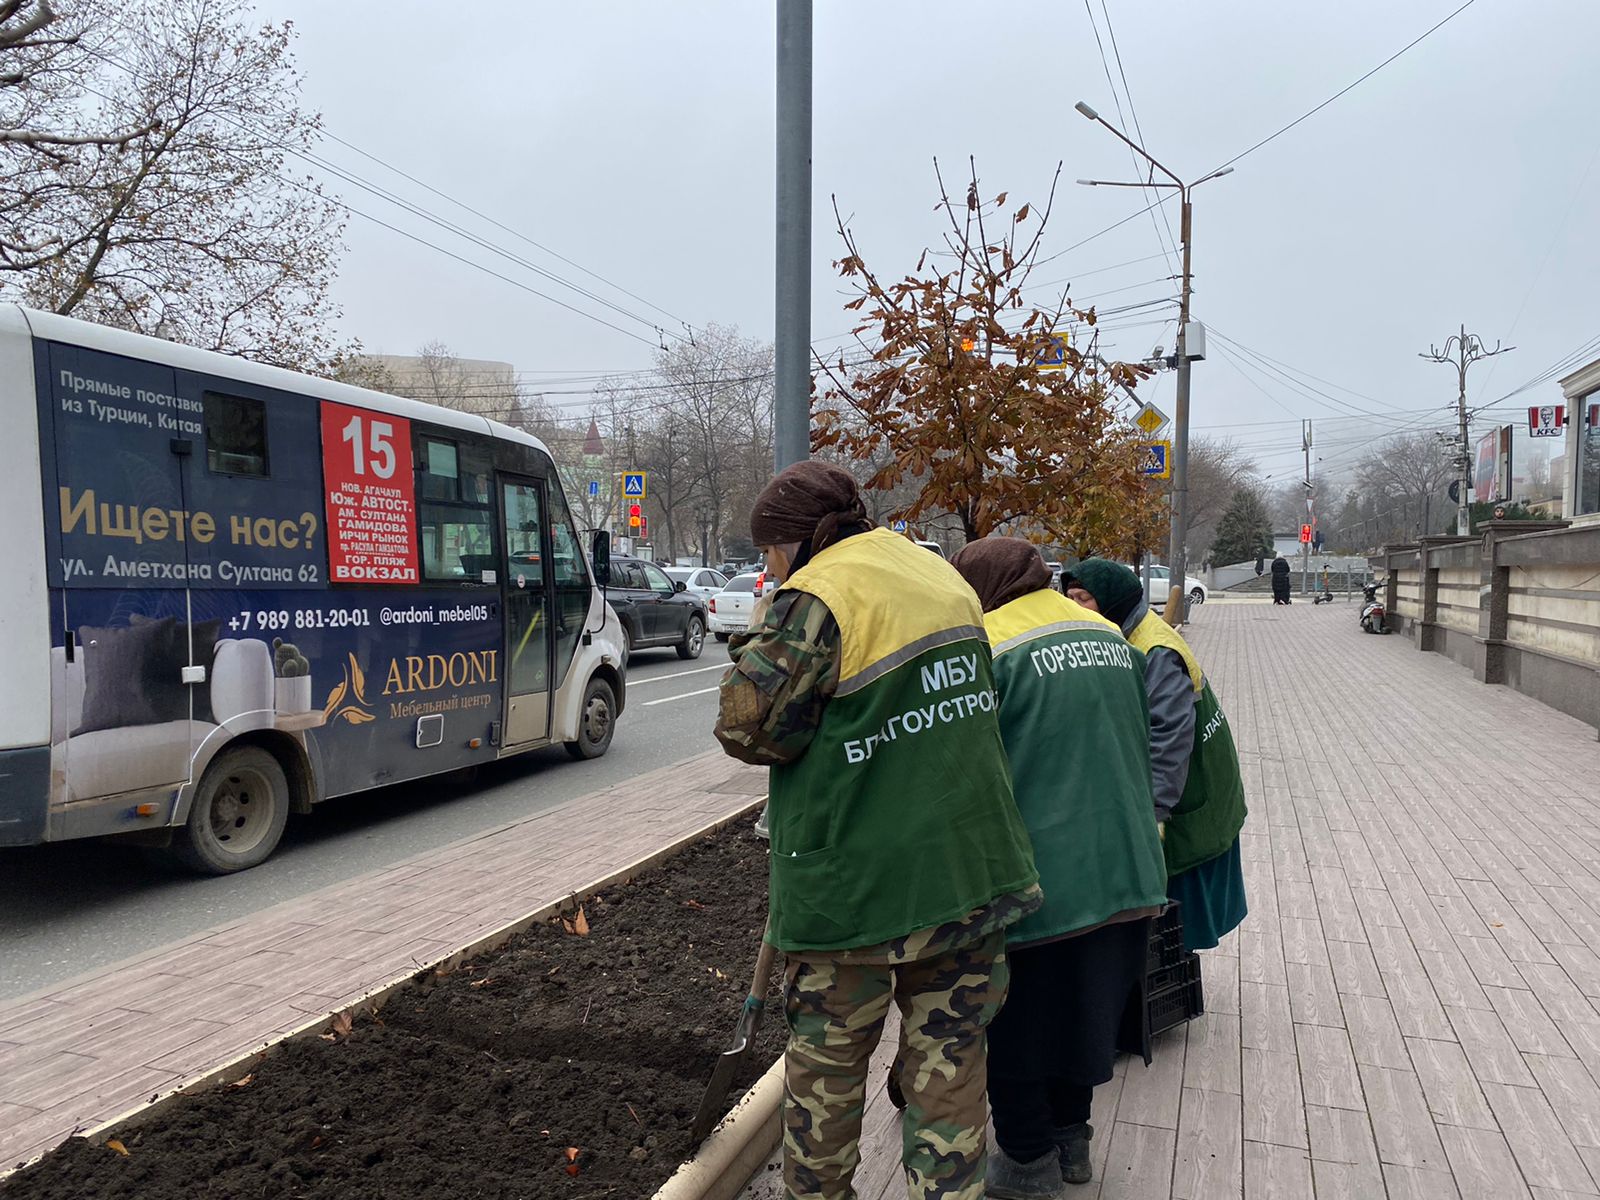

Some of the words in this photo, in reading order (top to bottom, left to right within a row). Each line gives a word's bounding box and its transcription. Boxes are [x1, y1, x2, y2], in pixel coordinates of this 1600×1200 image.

[60, 370, 132, 399] Прямые
[61, 398, 83, 413] из
[88, 399, 153, 428] Турции,
[158, 412, 202, 434] Китая
[342, 415, 396, 479] 15
[330, 491, 358, 506] Юж.
[361, 496, 412, 512] АВТОСТ.
[364, 485, 401, 498] АГАЧАУЛ
[60, 487, 216, 544] Ищете
[230, 512, 317, 549] нас?
[338, 508, 357, 518] АМ.
[360, 510, 407, 522] СУЛТАНА
[338, 519, 408, 533] ГАМИДОВА
[339, 530, 369, 541] ИРЧИ
[372, 533, 408, 544] РЫНОК
[60, 558, 94, 581] ул.
[103, 555, 212, 580] Аметхана
[218, 560, 293, 586] Султана
[298, 564, 318, 583] 62
[336, 565, 416, 580] ВОКЗАЛ
[345, 555, 371, 565] ГОР.
[373, 557, 406, 566] ПЛЯЖ
[228, 611, 251, 631] +7
[257, 610, 289, 630] 989
[295, 608, 370, 629] 881-20-01
[380, 605, 488, 625] @ardoni_mebel05
[1030, 640, 1133, 677] ГОРЗЕЛЕНХОЗ
[382, 650, 498, 695] ARDONI
[920, 653, 977, 694] МБУ
[390, 694, 459, 719] Мебельный
[461, 693, 491, 709] центр
